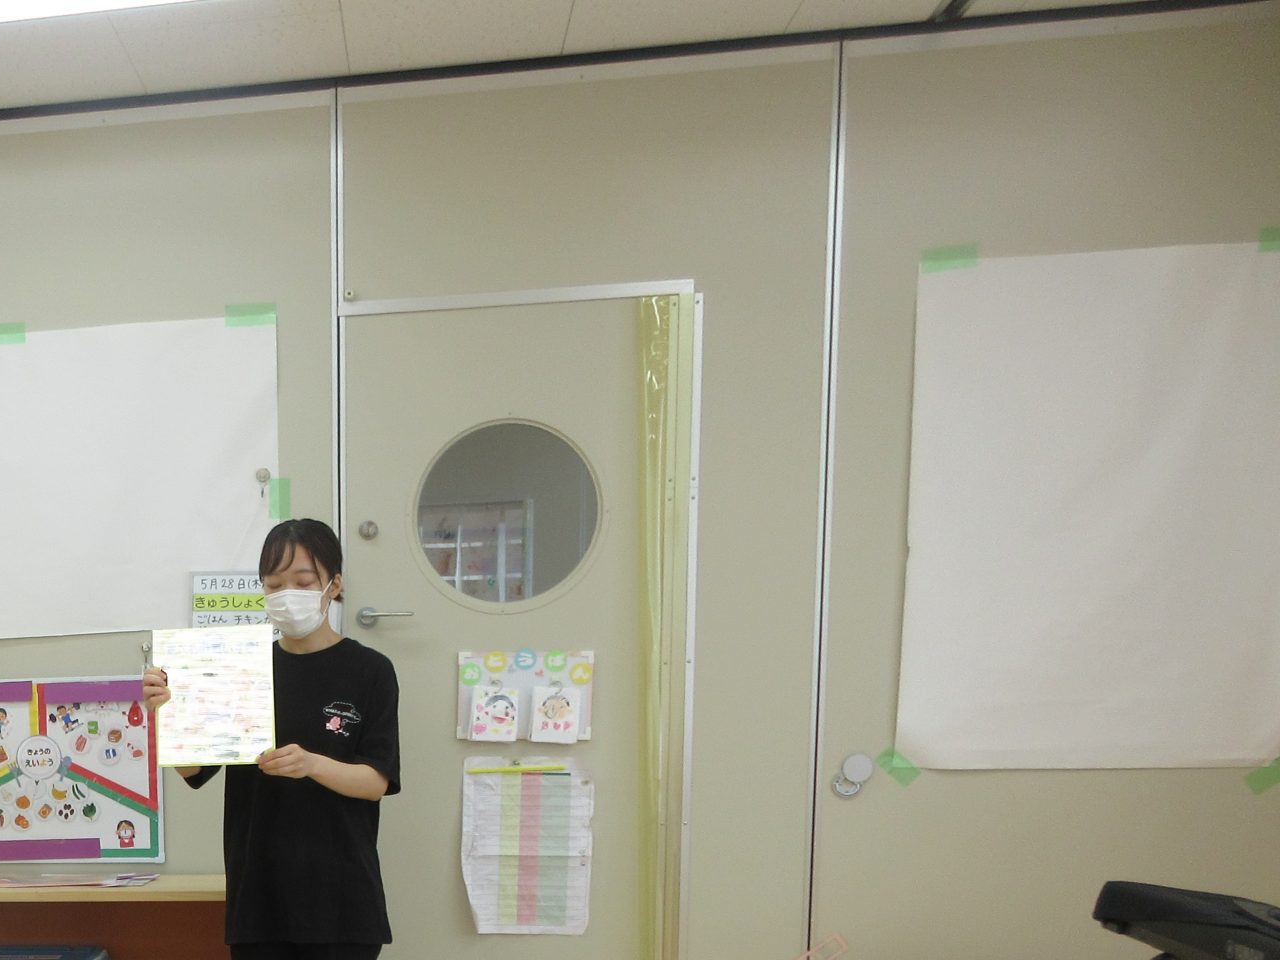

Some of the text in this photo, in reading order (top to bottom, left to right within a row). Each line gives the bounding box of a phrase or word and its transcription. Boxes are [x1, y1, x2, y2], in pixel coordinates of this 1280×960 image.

[195, 596, 265, 609] きゅうしょく
[27, 748, 51, 756] きょうの
[25, 758, 54, 768] えいよう
